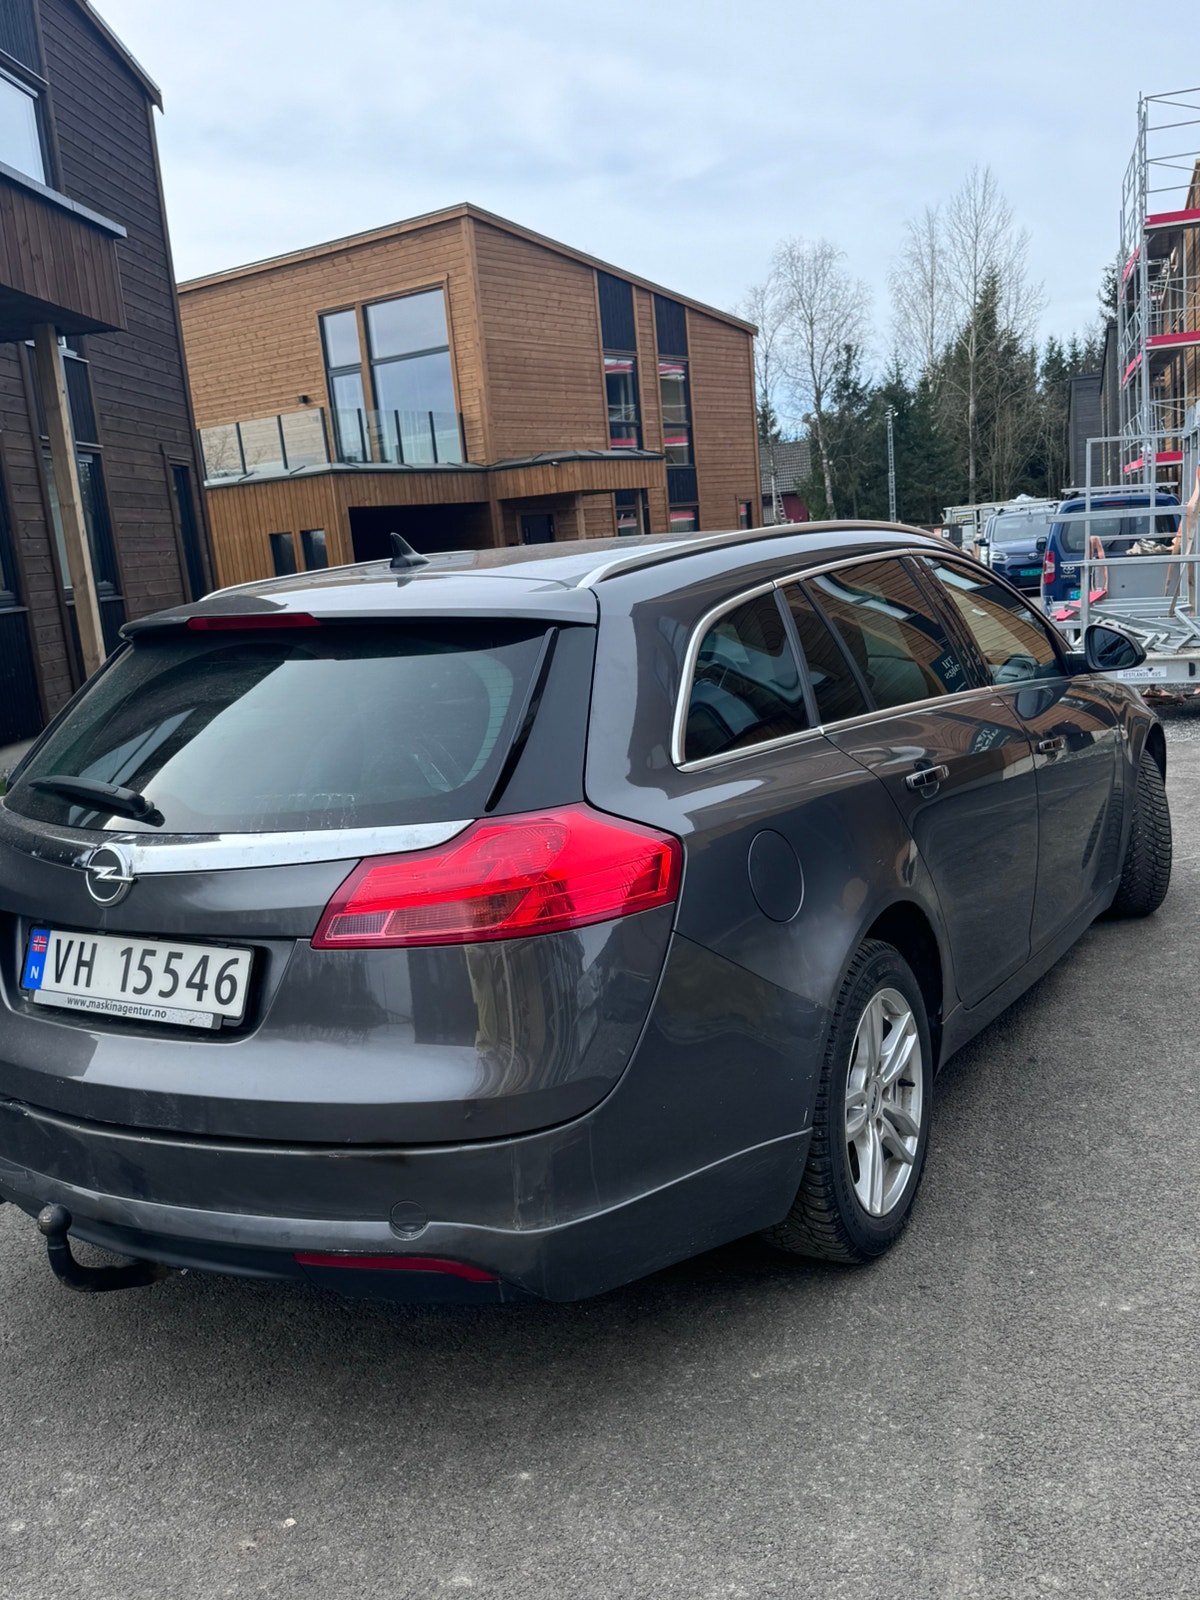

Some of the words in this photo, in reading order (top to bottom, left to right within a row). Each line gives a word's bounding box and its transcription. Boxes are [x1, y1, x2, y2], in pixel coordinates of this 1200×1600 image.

[29, 966, 40, 980] N
[55, 938, 98, 988] VH
[119, 946, 240, 1006] 15546
[66, 996, 167, 1019] www.maskinagentur.no
